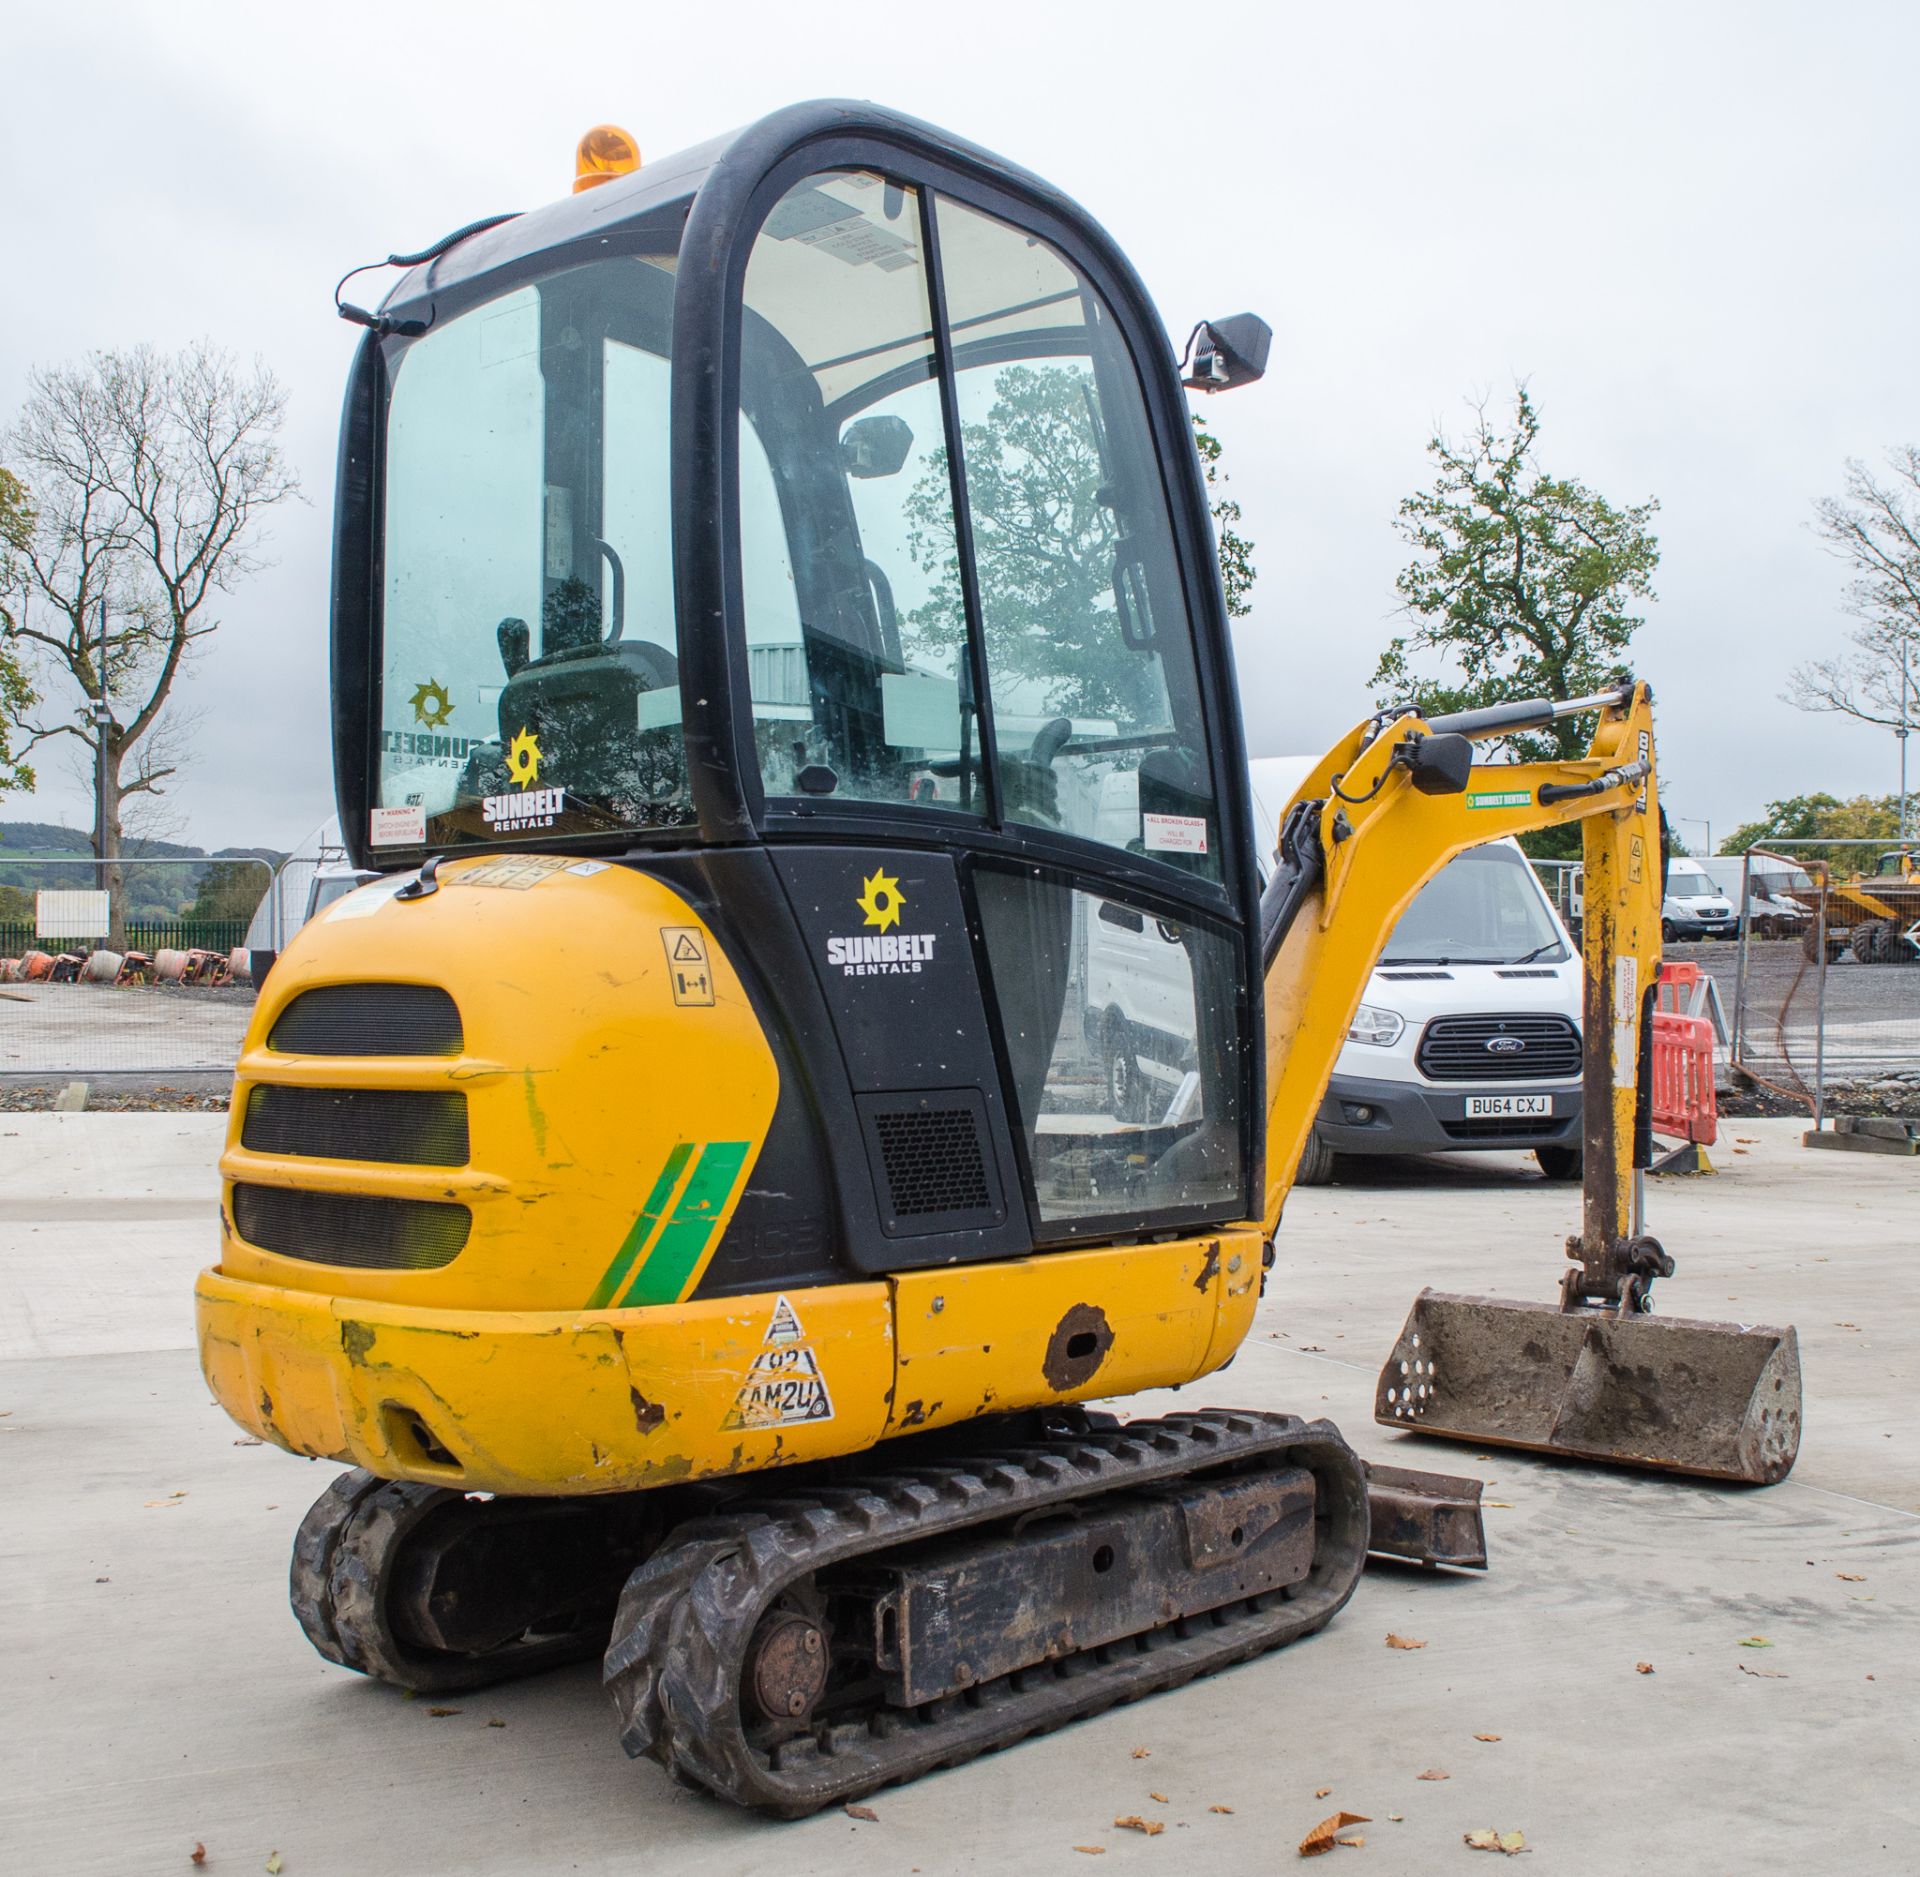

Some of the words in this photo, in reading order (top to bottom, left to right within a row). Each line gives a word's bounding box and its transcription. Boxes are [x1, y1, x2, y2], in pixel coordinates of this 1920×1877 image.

[483, 787, 566, 822] SUNBELT
[494, 815, 553, 832] RENTALS
[827, 934, 936, 965] SUNBELT
[844, 962, 922, 976] RENTALS
[1496, 1040, 1518, 1051] Ford
[1473, 1099, 1512, 1114] BU64
[1516, 1098, 1545, 1113] CXJ
